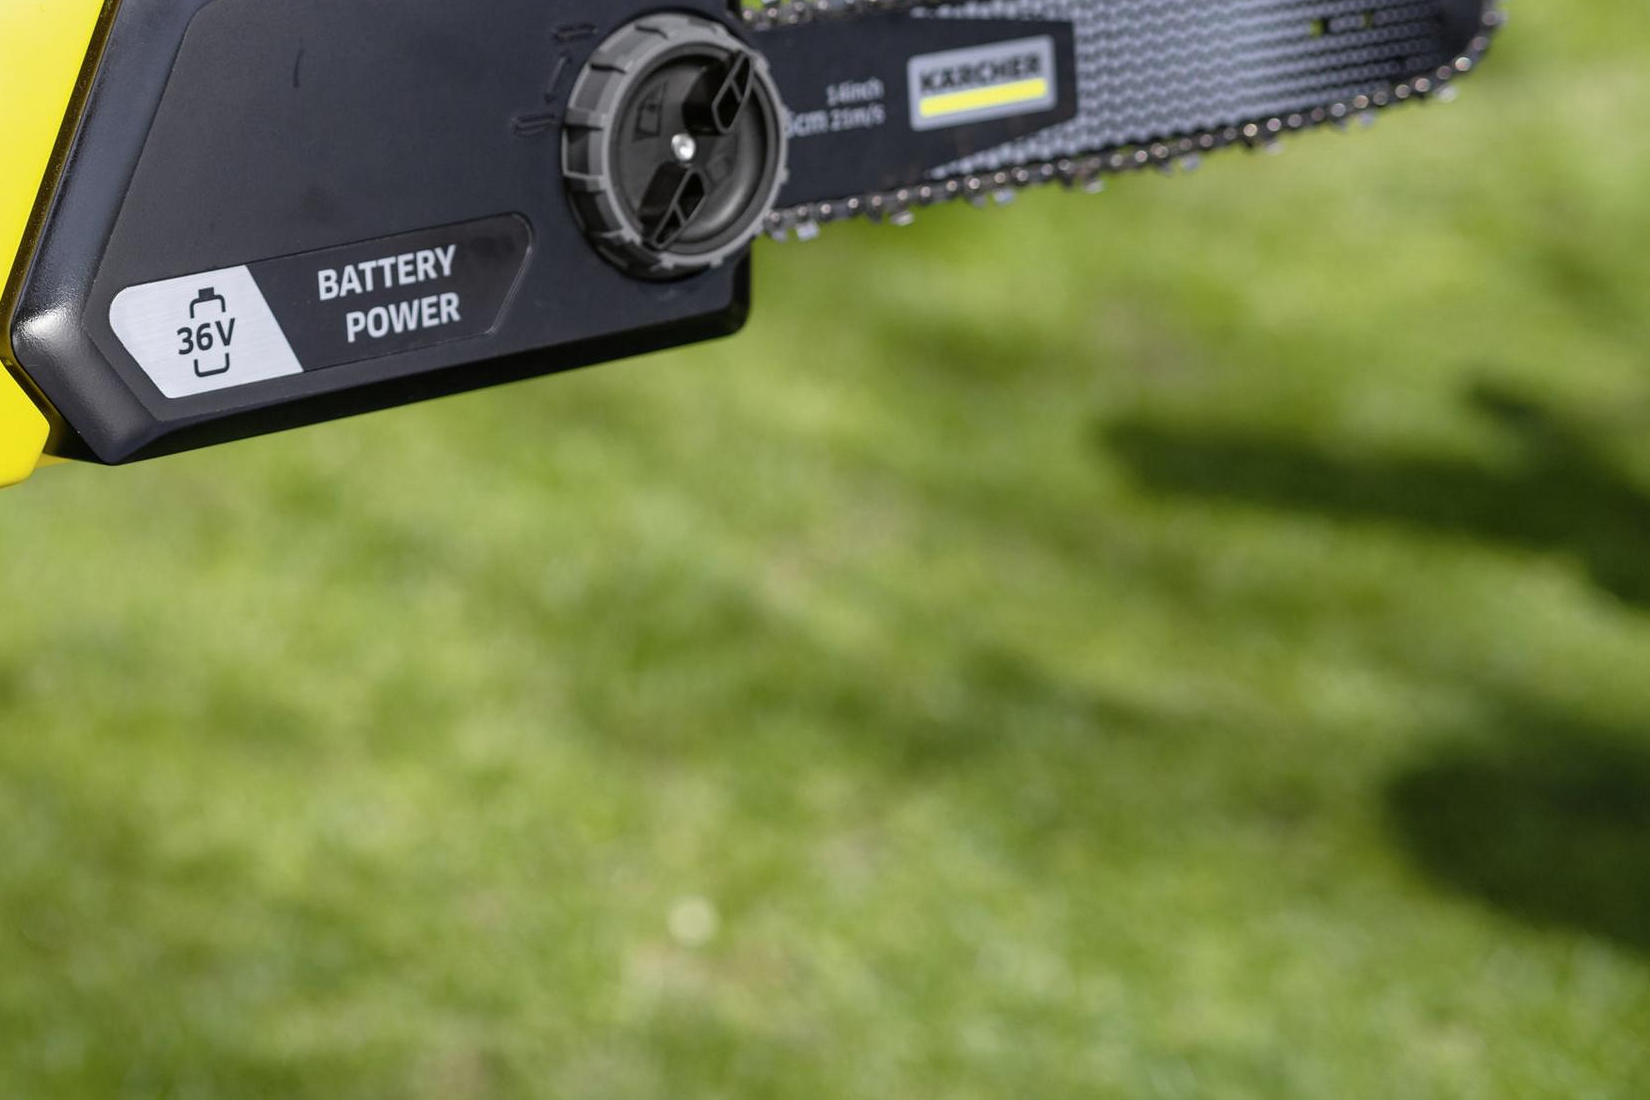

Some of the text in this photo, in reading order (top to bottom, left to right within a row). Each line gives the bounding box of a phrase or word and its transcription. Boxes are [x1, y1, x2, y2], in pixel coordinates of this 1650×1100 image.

[317, 244, 457, 301] BATTERY
[176, 317, 236, 355] 36V
[345, 292, 461, 343] POWER
